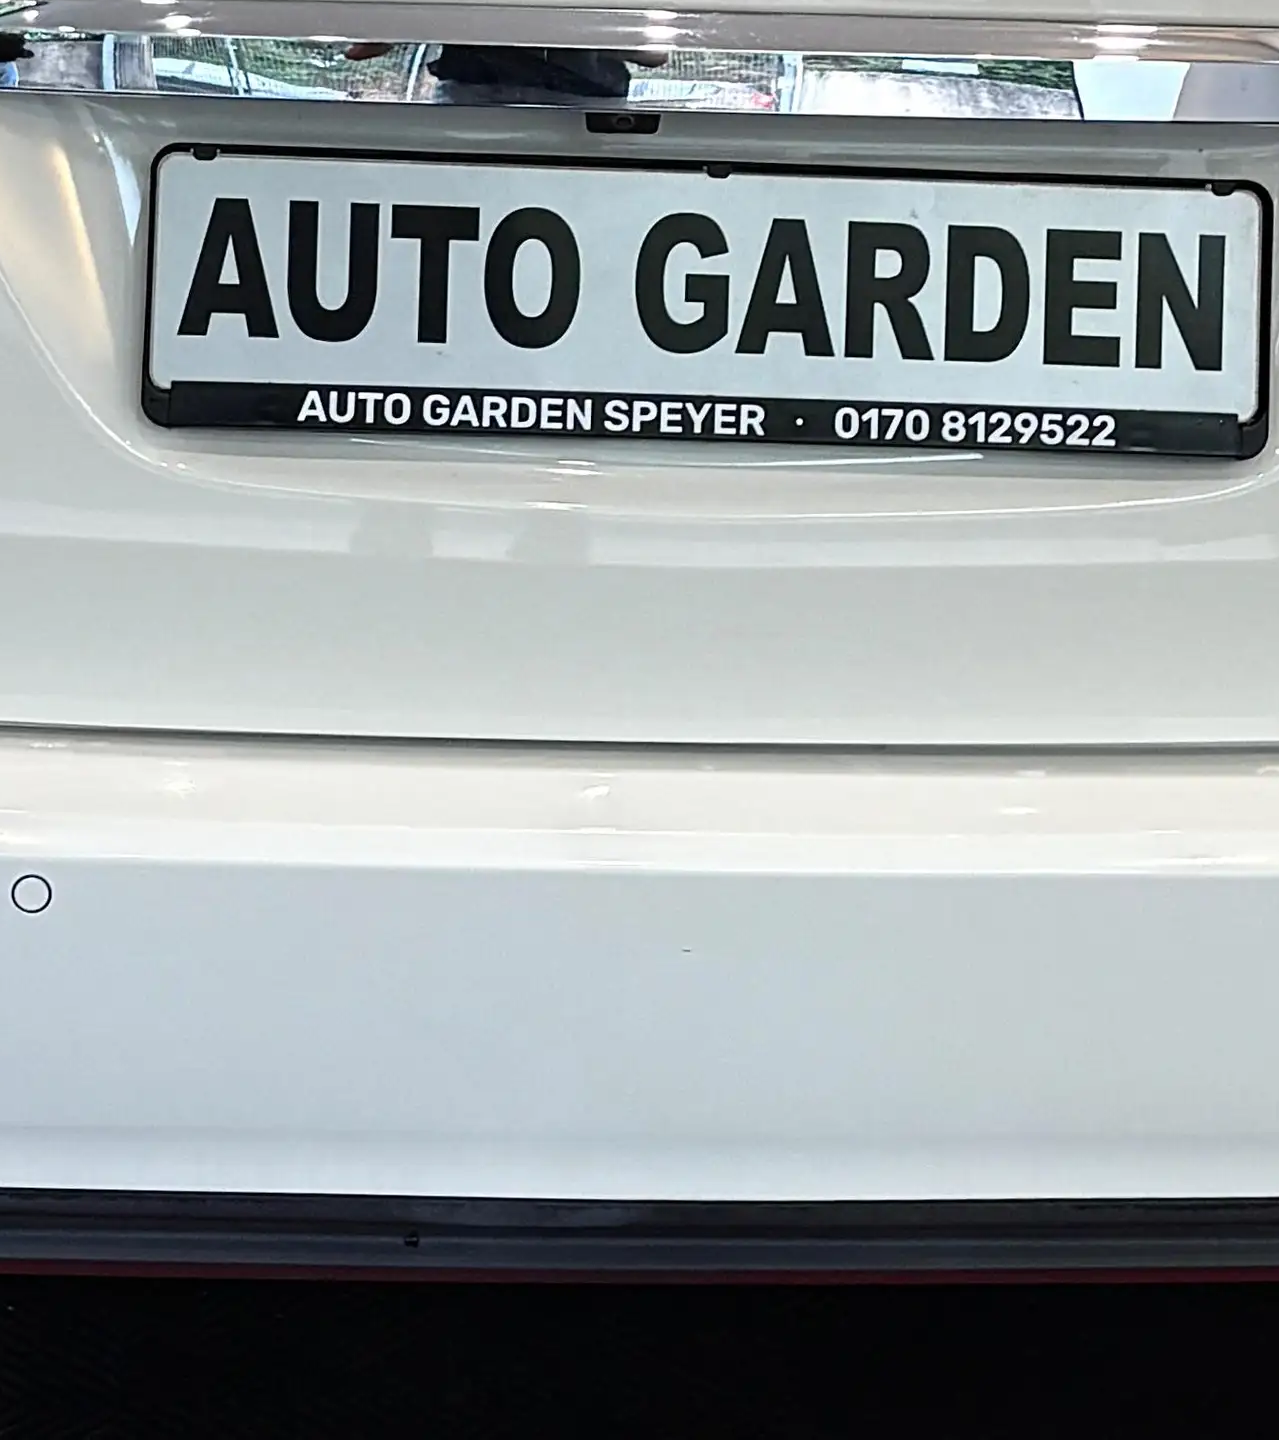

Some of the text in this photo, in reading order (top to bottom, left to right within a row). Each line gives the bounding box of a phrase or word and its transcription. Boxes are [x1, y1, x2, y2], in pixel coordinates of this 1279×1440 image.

[177, 197, 1227, 372] AUTO GARDEN
[296, 390, 412, 426] AUTO
[421, 394, 593, 432] GARDEN
[603, 398, 766, 437] SPEYER
[833, 406, 931, 442] 0170
[940, 409, 1117, 448] 8129522
